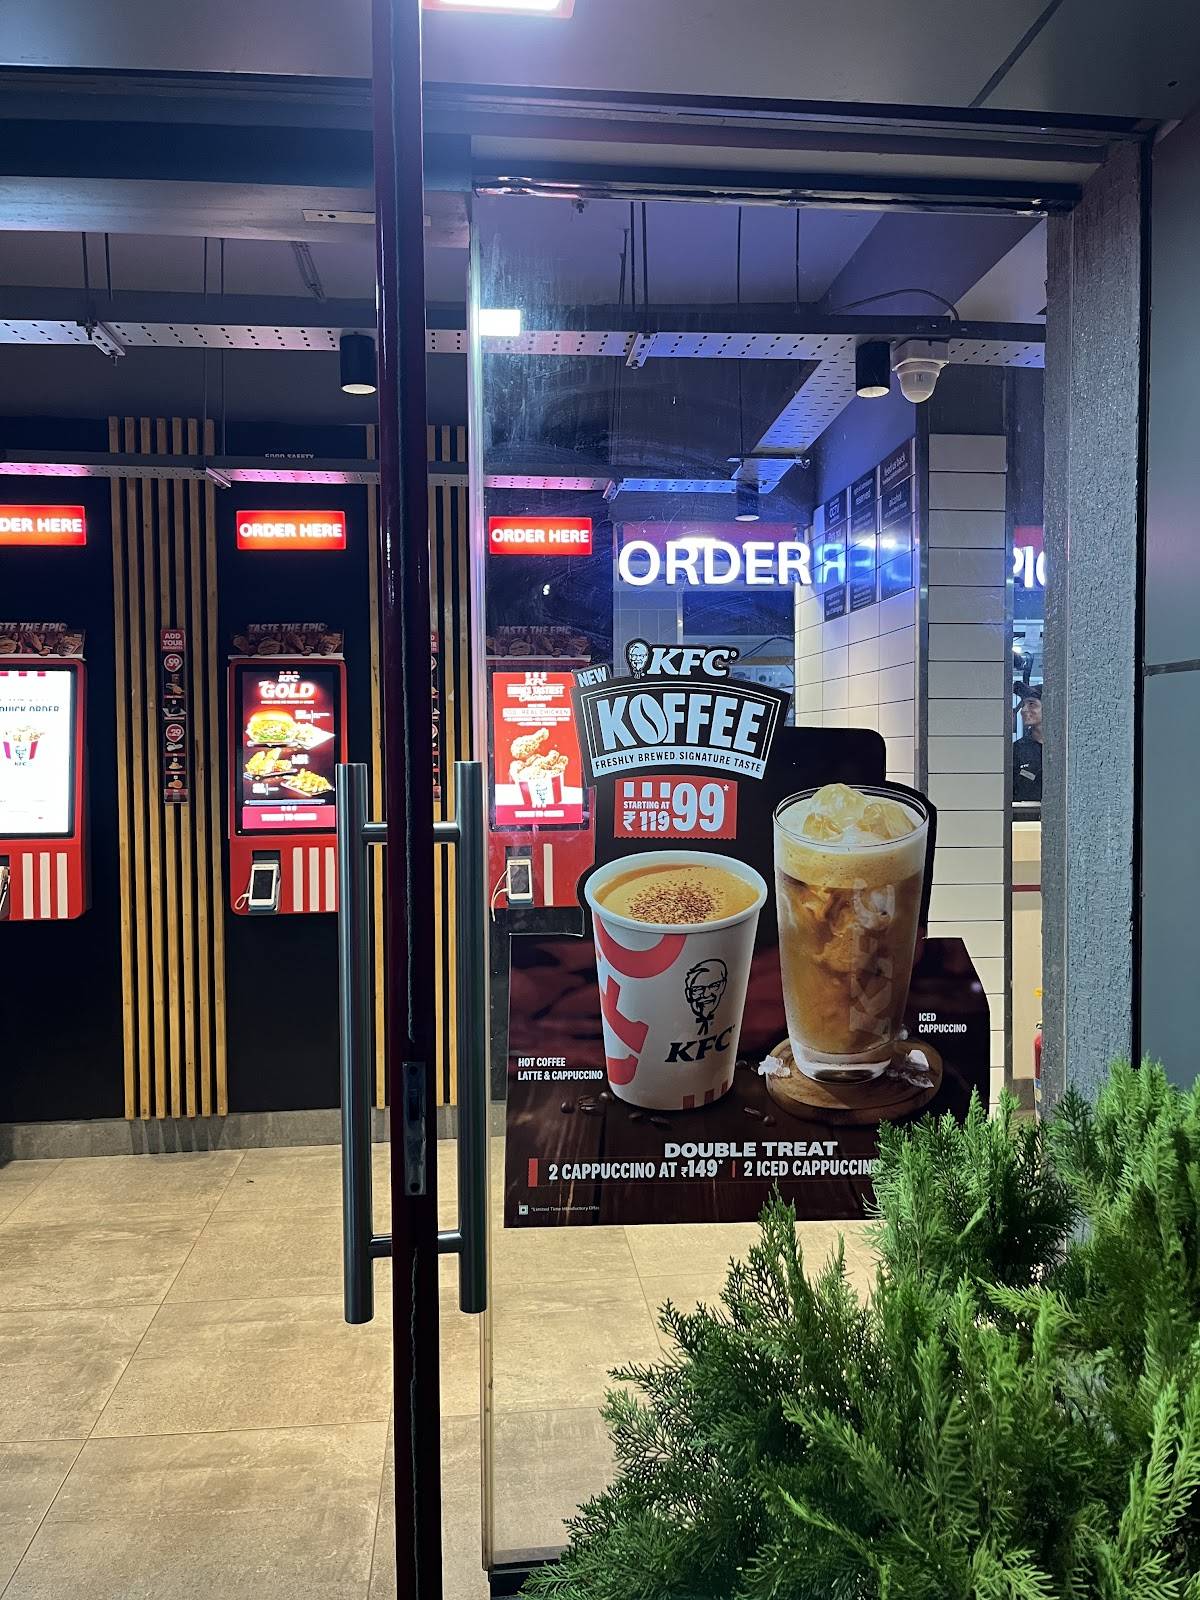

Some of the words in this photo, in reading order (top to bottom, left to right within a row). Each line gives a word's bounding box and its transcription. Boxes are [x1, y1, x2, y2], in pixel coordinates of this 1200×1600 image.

[37, 518, 83, 533] HERE
[239, 523, 297, 538] ORDER
[299, 523, 343, 538] HERE
[491, 528, 545, 543] ORDER
[549, 529, 589, 543] HERE
[618, 538, 813, 586] ORDER
[19, 622, 41, 632] THE
[248, 623, 279, 633] TASTE
[281, 623, 301, 633] THE
[577, 666, 608, 688] NEW
[260, 683, 315, 698] GOLD
[596, 692, 766, 754] KOFFEE
[595, 754, 634, 770] FRESHLY
[679, 751, 730, 766] SIGNATURE
[734, 758, 762, 773] TASTE
[623, 801, 659, 810] STARTING
[660, 801, 670, 810] AT
[918, 1012, 937, 1022] ICED
[918, 1023, 967, 1033] CAPPUCCINO
[664, 1029, 733, 1063] KFC
[517, 1057, 535, 1067] HOT
[536, 1057, 566, 1067] COFFEE
[517, 1070, 543, 1081] LATTE
[543, 1070, 551, 1080] &
[551, 1070, 604, 1080] CAPPUCCINO
[664, 1142, 757, 1159] DOUBLE
[762, 1141, 838, 1157] TREAT
[548, 1164, 558, 1180] 2
[561, 1161, 656, 1180] CAPPUCCINO
[659, 1161, 678, 1178] AT
[743, 1161, 753, 1177] 2
[757, 1160, 789, 1177] ICED
[792, 1159, 874, 1176] CAPPUCCIN
